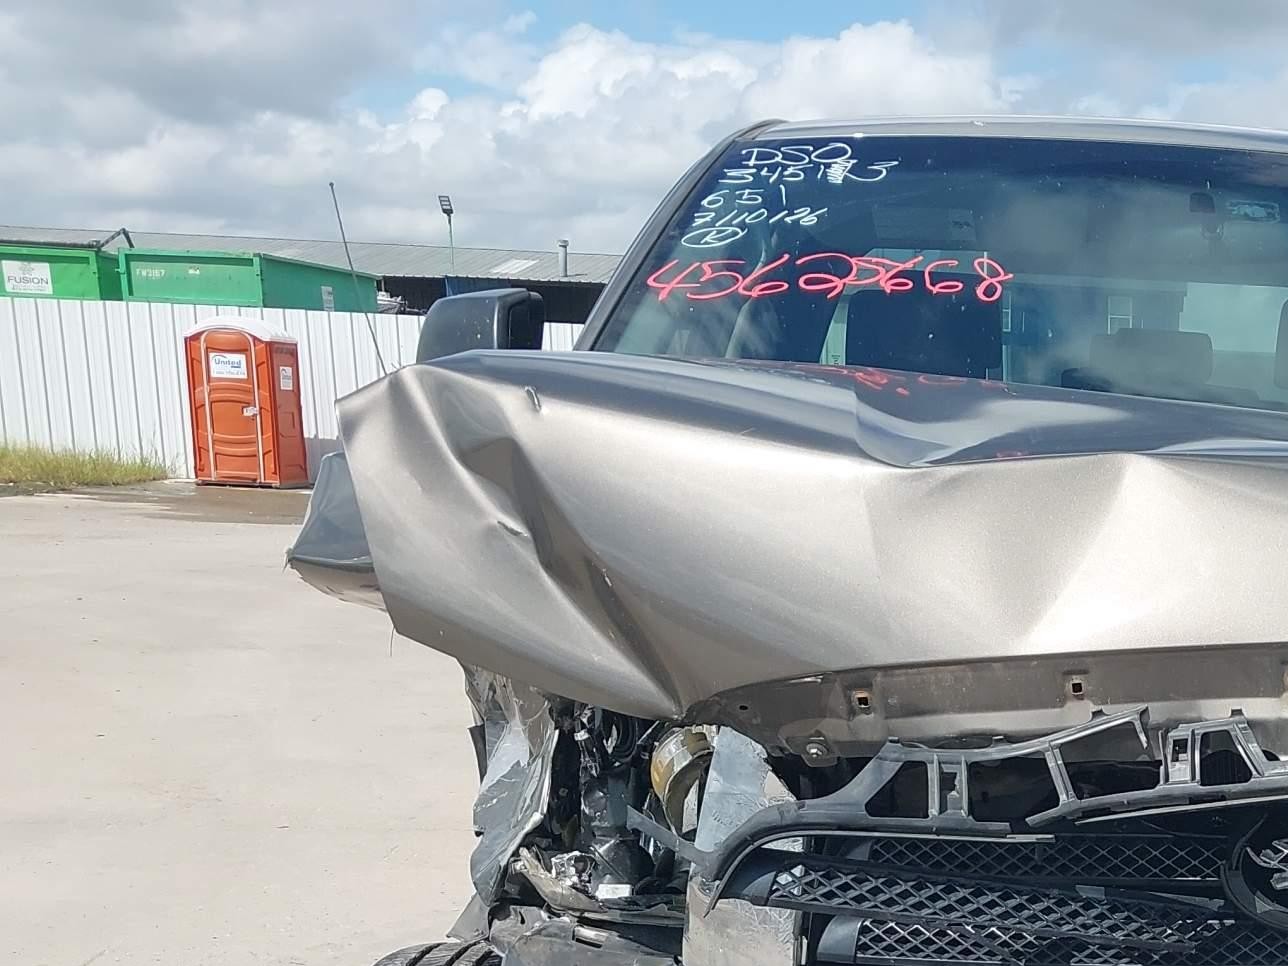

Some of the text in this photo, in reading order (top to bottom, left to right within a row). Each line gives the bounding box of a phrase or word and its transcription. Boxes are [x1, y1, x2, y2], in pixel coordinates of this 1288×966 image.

[7, 275, 49, 285] FUSION
[647, 252, 1014, 301] 45625668
[214, 358, 242, 366] United
